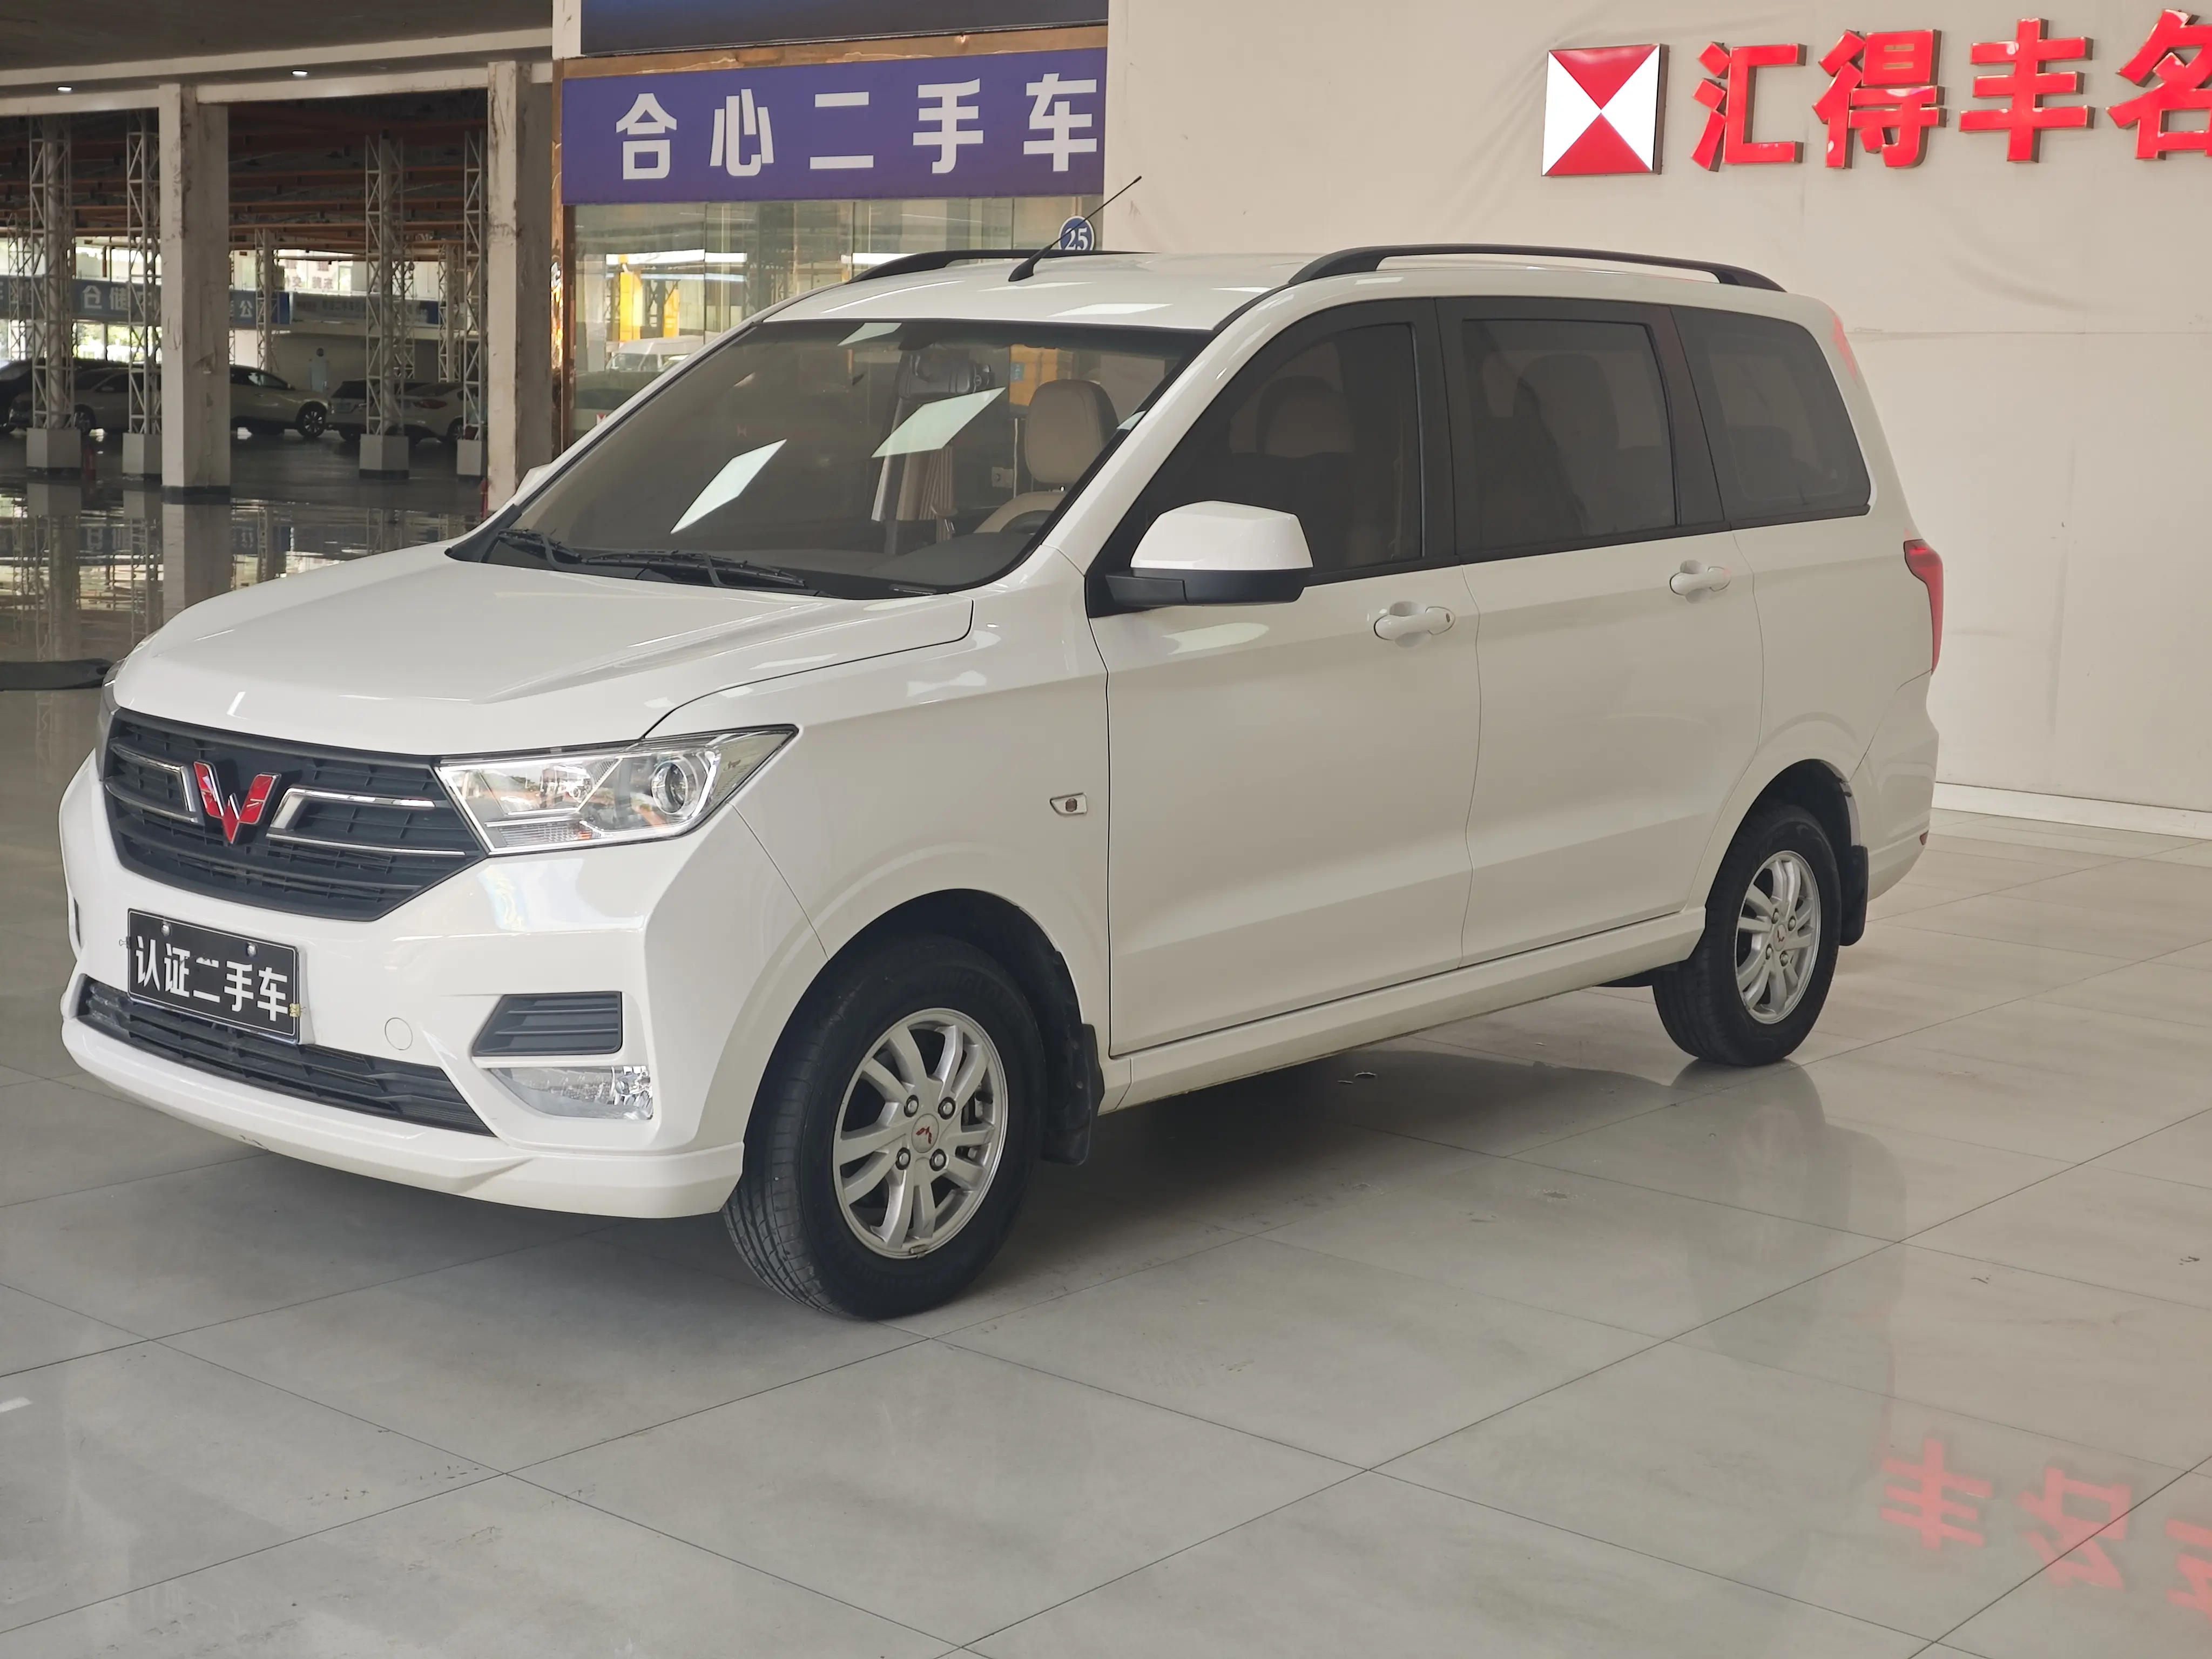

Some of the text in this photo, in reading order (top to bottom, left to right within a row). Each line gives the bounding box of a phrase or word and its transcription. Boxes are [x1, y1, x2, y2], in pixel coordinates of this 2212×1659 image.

[616, 73, 1098, 180] 合心二手车
[1691, 8, 2212, 172] 汇得丰名
[1064, 227, 1089, 251] 25
[135, 935, 288, 1022] 认证二手车
